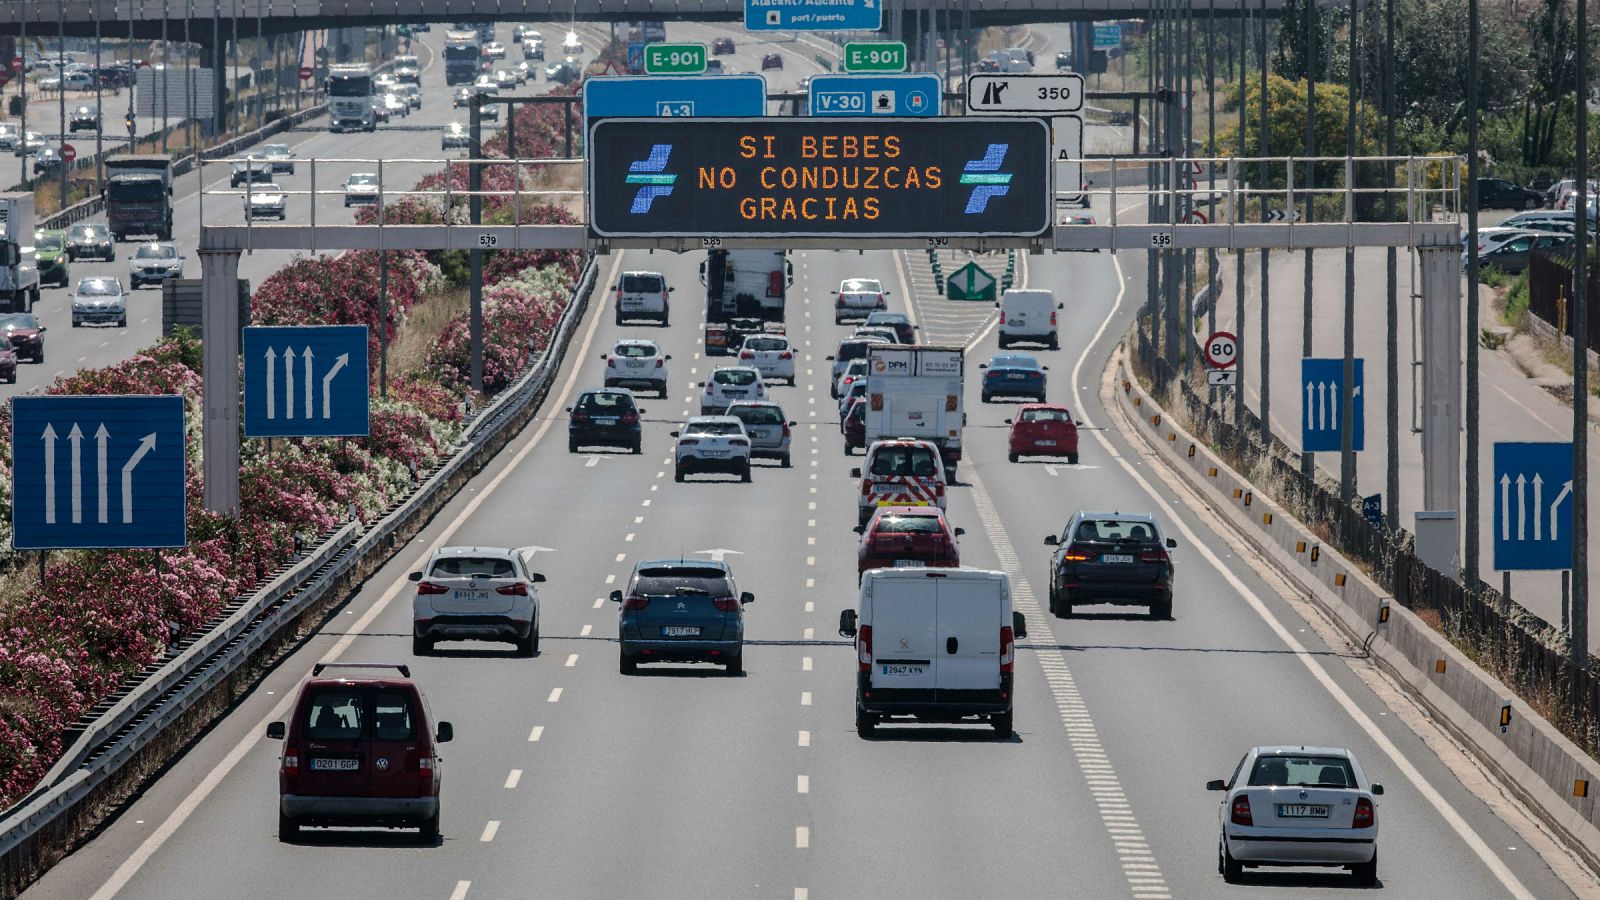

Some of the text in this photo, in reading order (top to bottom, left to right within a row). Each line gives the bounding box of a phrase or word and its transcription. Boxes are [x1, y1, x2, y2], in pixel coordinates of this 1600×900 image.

[791, 13, 846, 23] port/puerto
[652, 51, 699, 67] E-901
[851, 50, 899, 65] E-901
[1038, 87, 1071, 101] 350
[821, 95, 861, 109] V-30
[661, 104, 691, 117] A-3
[739, 135, 901, 159] SI BEBES
[699, 166, 942, 190] NO CONDUZCAS
[739, 196, 881, 221] GRACIAS
[1211, 343, 1233, 357] 80
[888, 361, 907, 369] DFM
[1363, 501, 1380, 511] A-3
[316, 759, 358, 769] 0201 GGP
[1285, 805, 1306, 815] 1117
